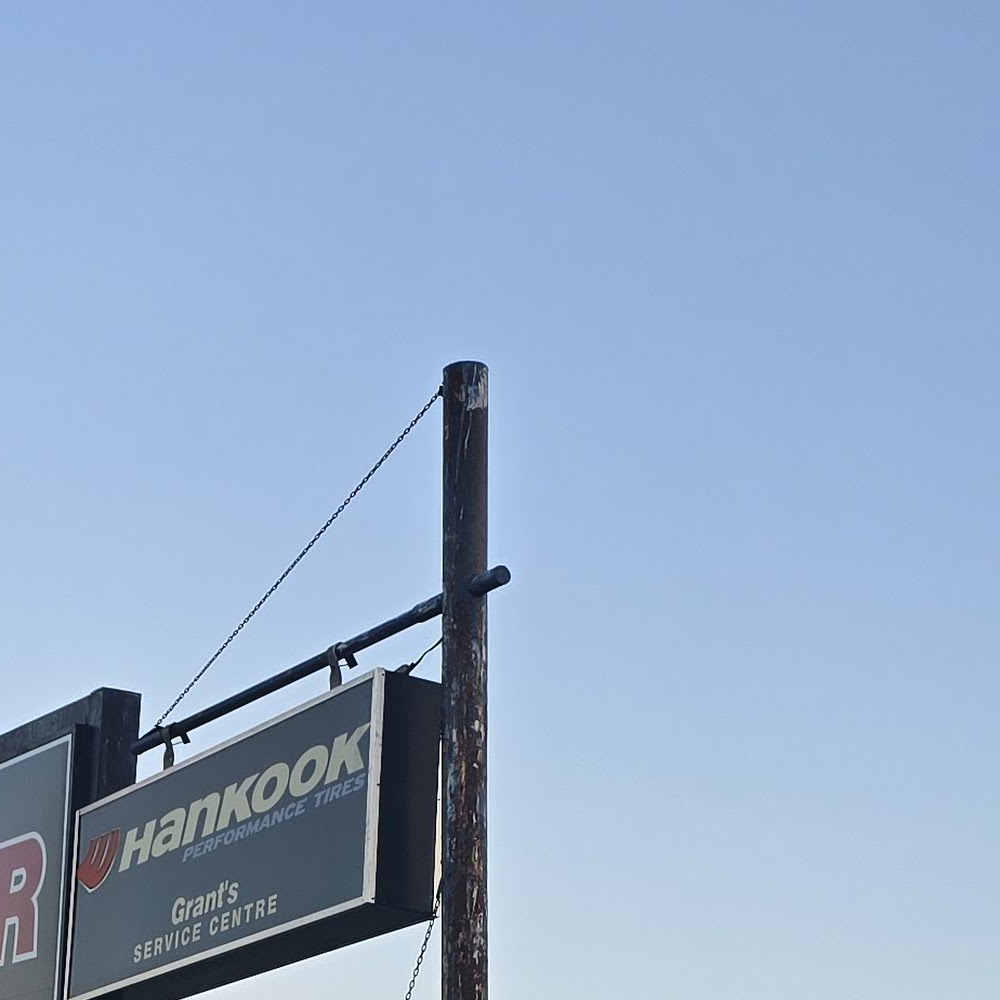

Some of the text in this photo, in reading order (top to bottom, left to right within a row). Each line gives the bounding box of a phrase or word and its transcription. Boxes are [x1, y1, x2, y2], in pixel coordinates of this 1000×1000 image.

[182, 772, 366, 862] PERFORMANCE TIRES
[133, 894, 278, 963] SERVICE CENTRE
[171, 880, 239, 925] Grant's
